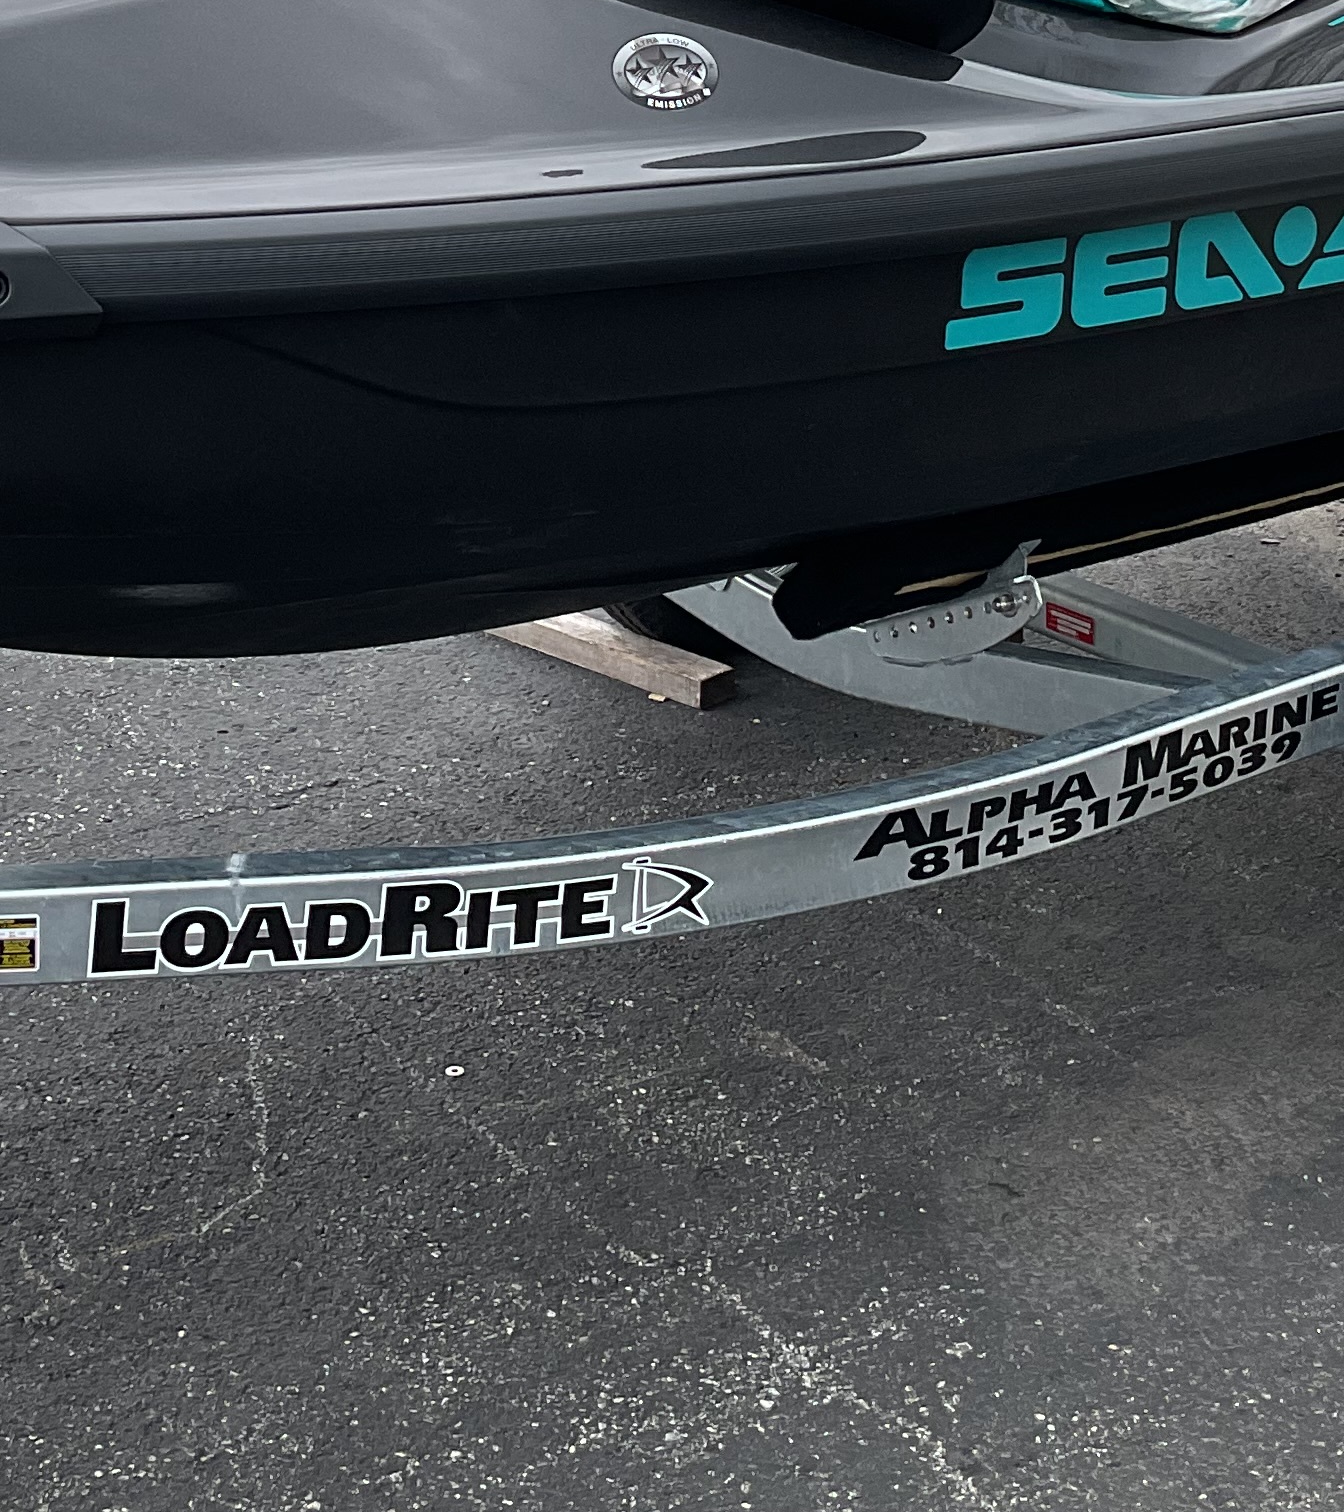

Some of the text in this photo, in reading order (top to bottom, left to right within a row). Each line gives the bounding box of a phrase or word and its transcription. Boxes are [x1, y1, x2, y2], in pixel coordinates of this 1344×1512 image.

[630, 37, 690, 51] ULTRA LOW
[647, 93, 702, 109] EMISSION
[852, 683, 1341, 862] ALPHA MARINE
[907, 730, 1302, 882] 814-317-5039
[88, 875, 619, 977] LOADRITE
